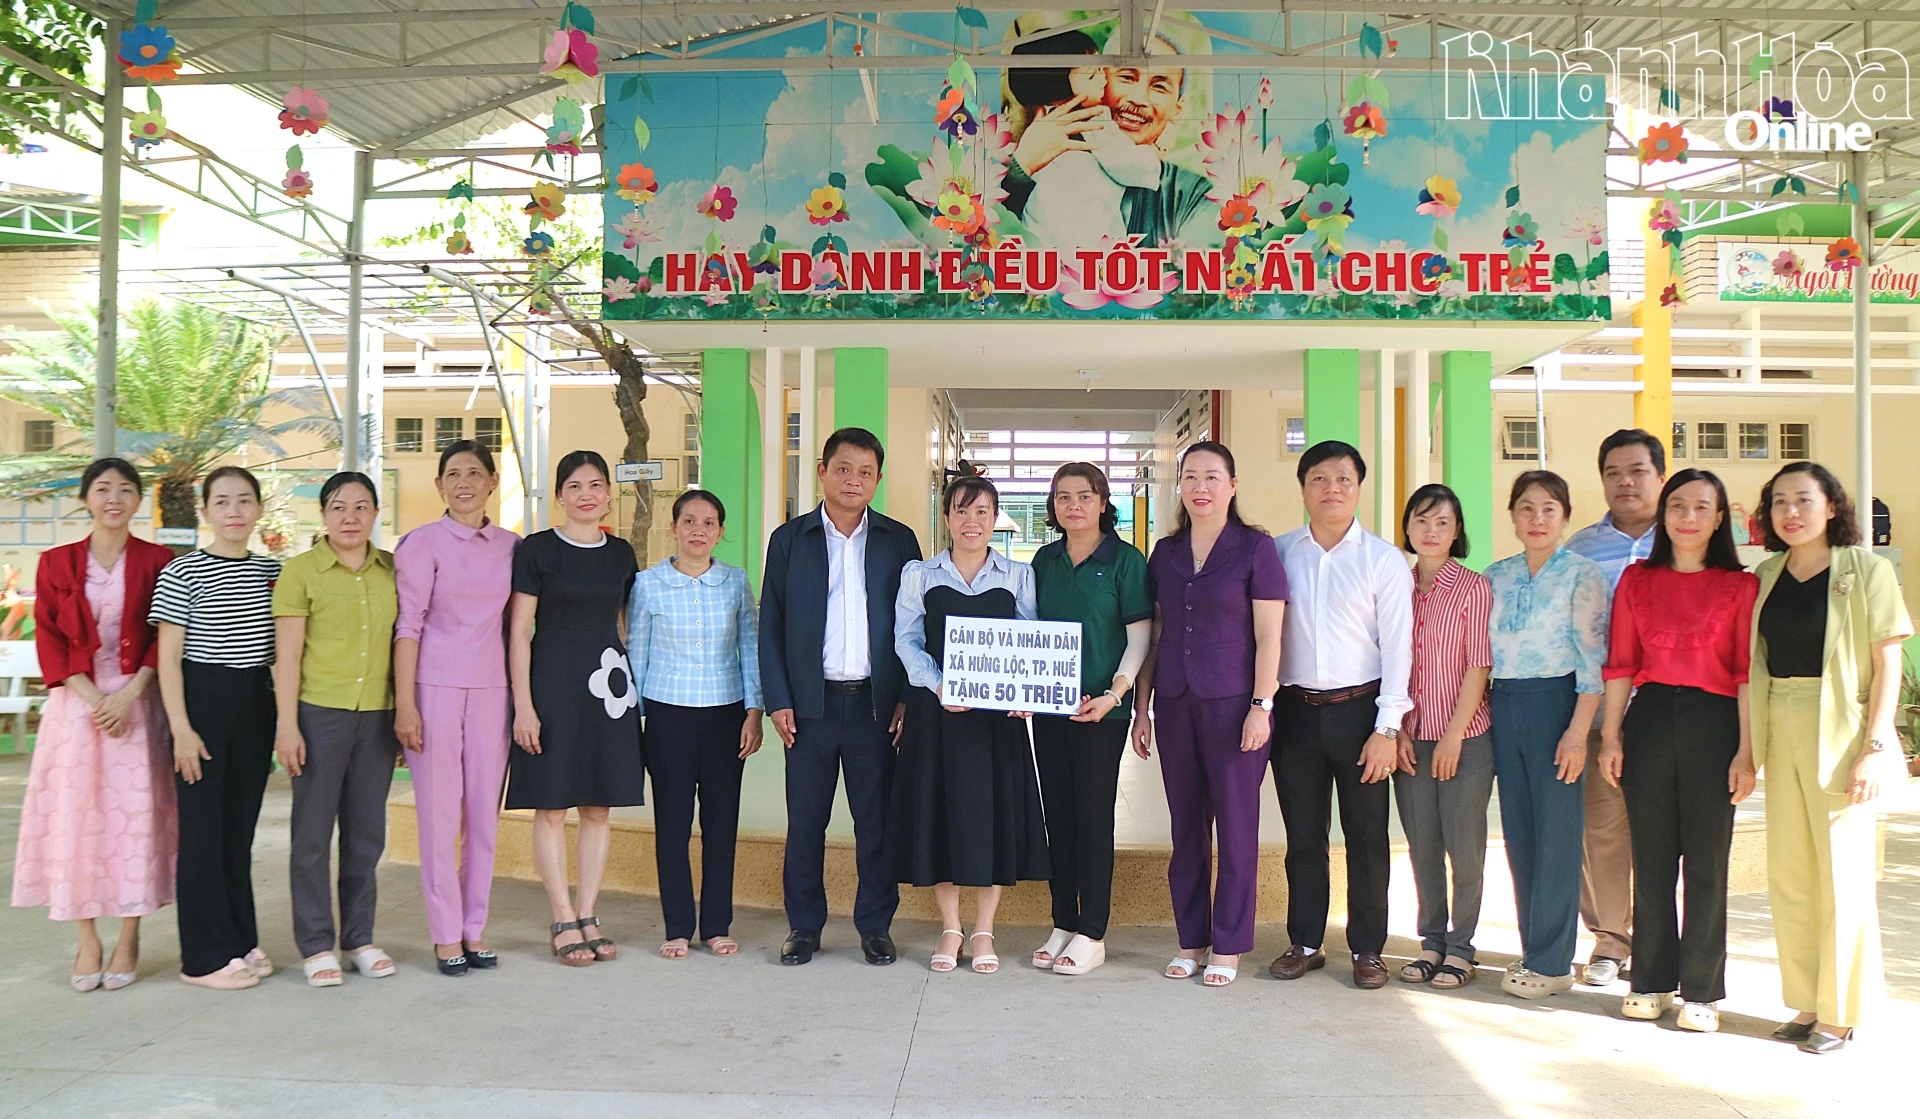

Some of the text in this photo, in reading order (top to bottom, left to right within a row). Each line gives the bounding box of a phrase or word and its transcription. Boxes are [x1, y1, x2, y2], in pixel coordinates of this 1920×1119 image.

[1075, 236, 1167, 292] TỐT
[1186, 238, 1316, 291] NẤT
[1460, 239, 1552, 293] TRẺ
[950, 626, 1079, 650] CÁN BỘ VÀ NHÂN DÂN
[949, 651, 1077, 679] XÃ HƯNG LỘC, TP. HUẾ
[948, 678, 1077, 710] TẶNG 50 TRIỆU
